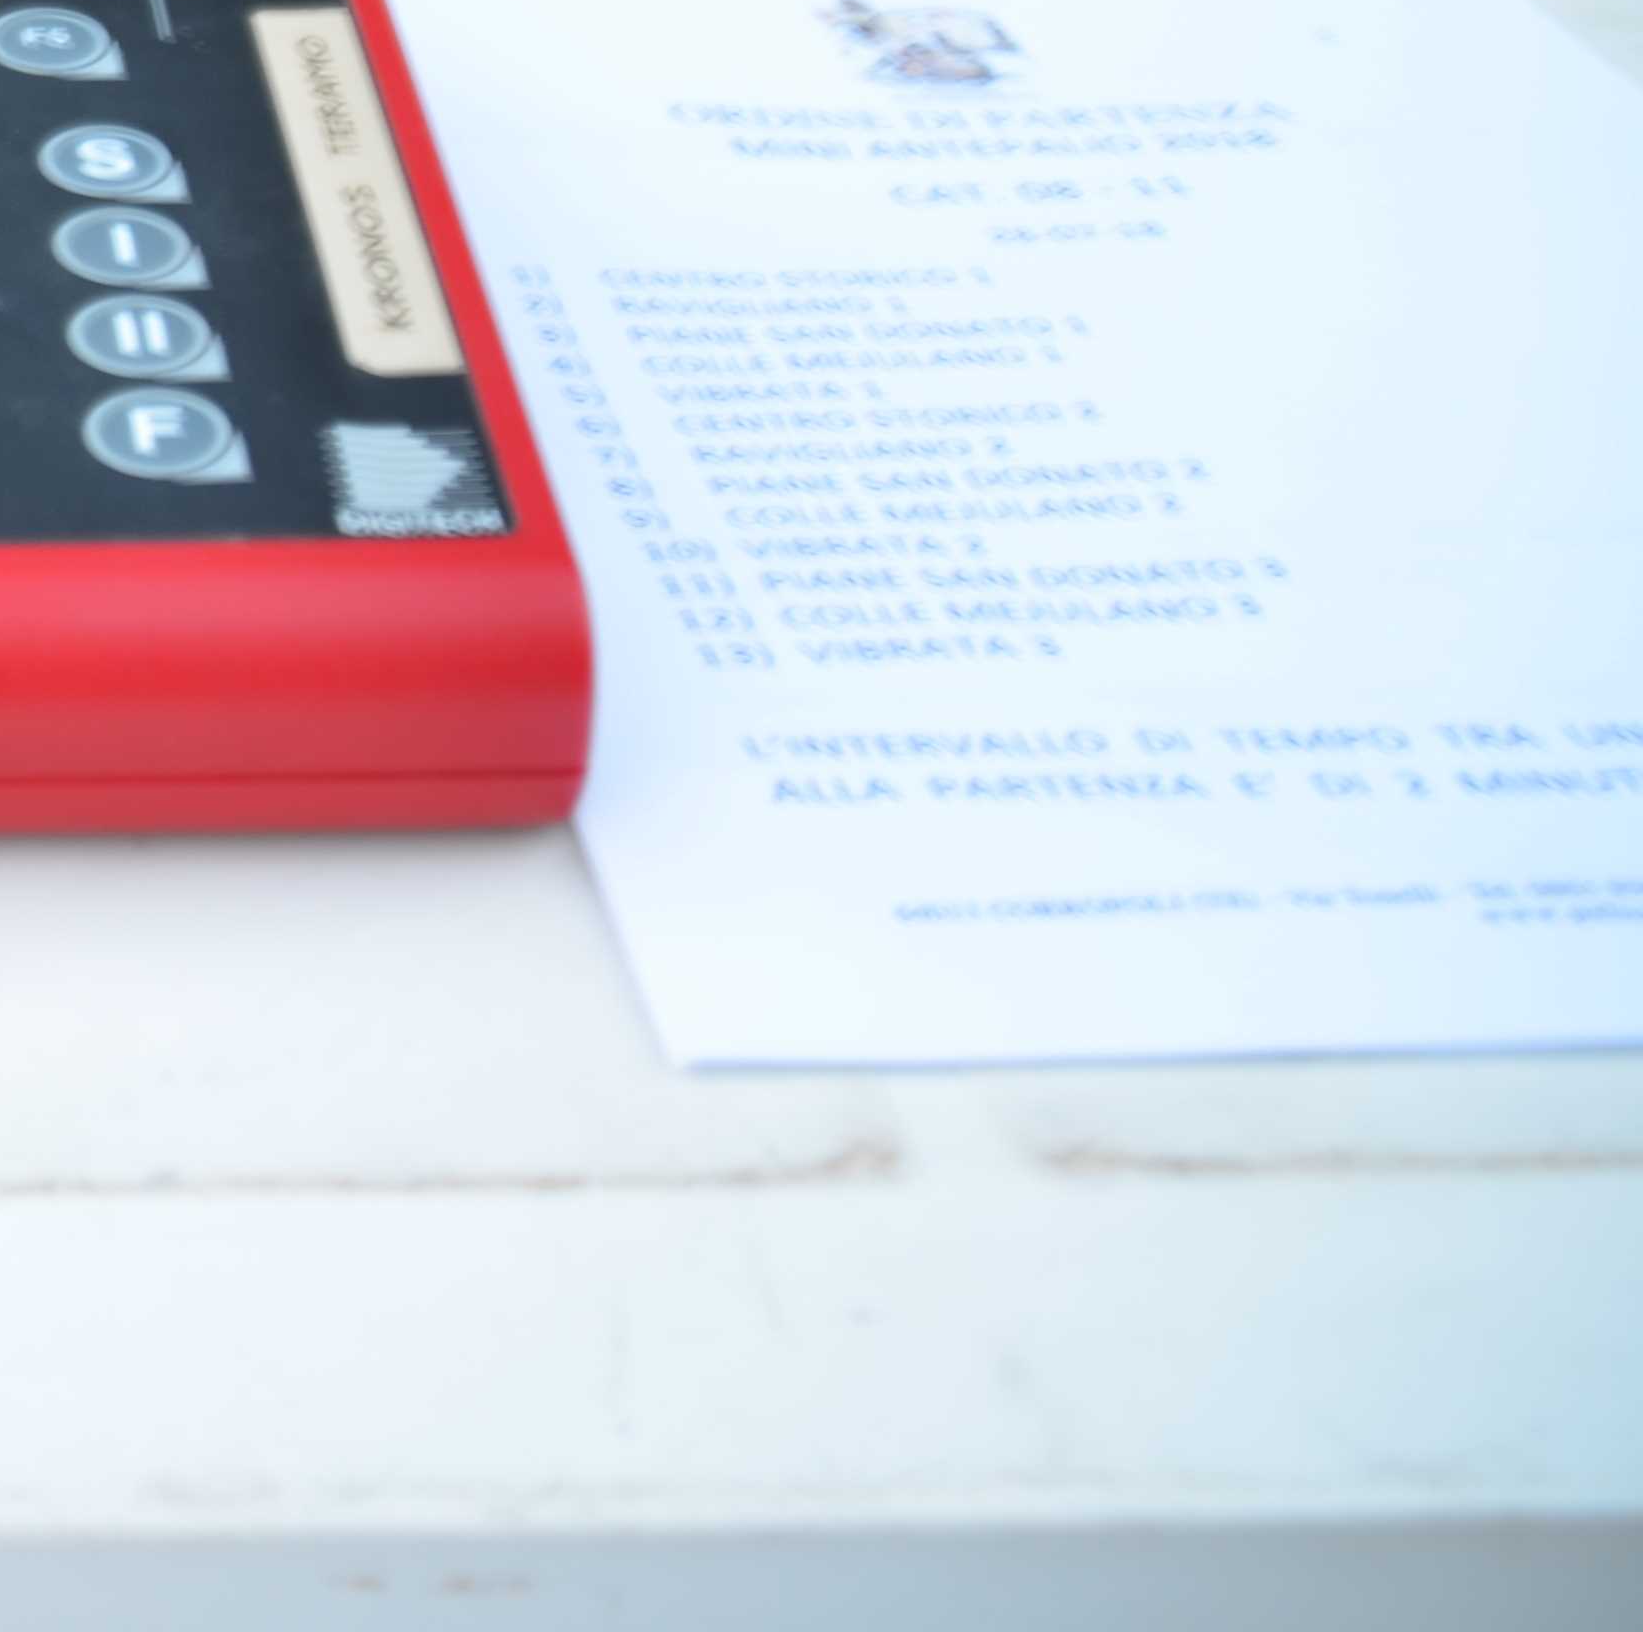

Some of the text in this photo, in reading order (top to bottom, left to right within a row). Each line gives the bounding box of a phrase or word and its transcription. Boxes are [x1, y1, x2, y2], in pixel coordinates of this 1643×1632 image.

[19, 26, 70, 48] F5
[299, 35, 363, 158] TERAMO
[75, 138, 137, 181] S
[339, 183, 414, 334] KRONOS
[657, 380, 847, 406] VIBRATA
[861, 380, 886, 402] 1
[128, 404, 189, 456] F
[673, 411, 857, 436] CENTRO
[867, 401, 1067, 430] STORICO
[1075, 398, 1103, 424] 2
[689, 438, 973, 466] RAVIGLIANO
[985, 436, 1017, 460] 2
[711, 472, 847, 498] PIANE
[859, 472, 955, 496] SAN
[965, 456, 1170, 492] DONATO
[1183, 454, 1213, 482] 2
[725, 506, 869, 532] COLLE
[1157, 488, 1187, 518] 2
[739, 534, 945, 566] VIBRATA
[961, 534, 989, 560] 2
[761, 568, 909, 598] PIANE
[923, 568, 1021, 596] SAN
[1029, 560, 1248, 590] DONATO
[1261, 554, 1291, 582] 3
[779, 604, 933, 632] COLLE
[1233, 592, 1263, 620] 3
[799, 636, 1021, 670] VIBRATA
[1033, 634, 1065, 660] 3
[1131, 724, 1195, 758] DI
[1211, 720, 1417, 756] TEMPO
[1431, 716, 1547, 750] TRA
[767, 772, 905, 806] ALLA
[921, 768, 1213, 804] PARTENZA
[1305, 768, 1375, 802] DI
